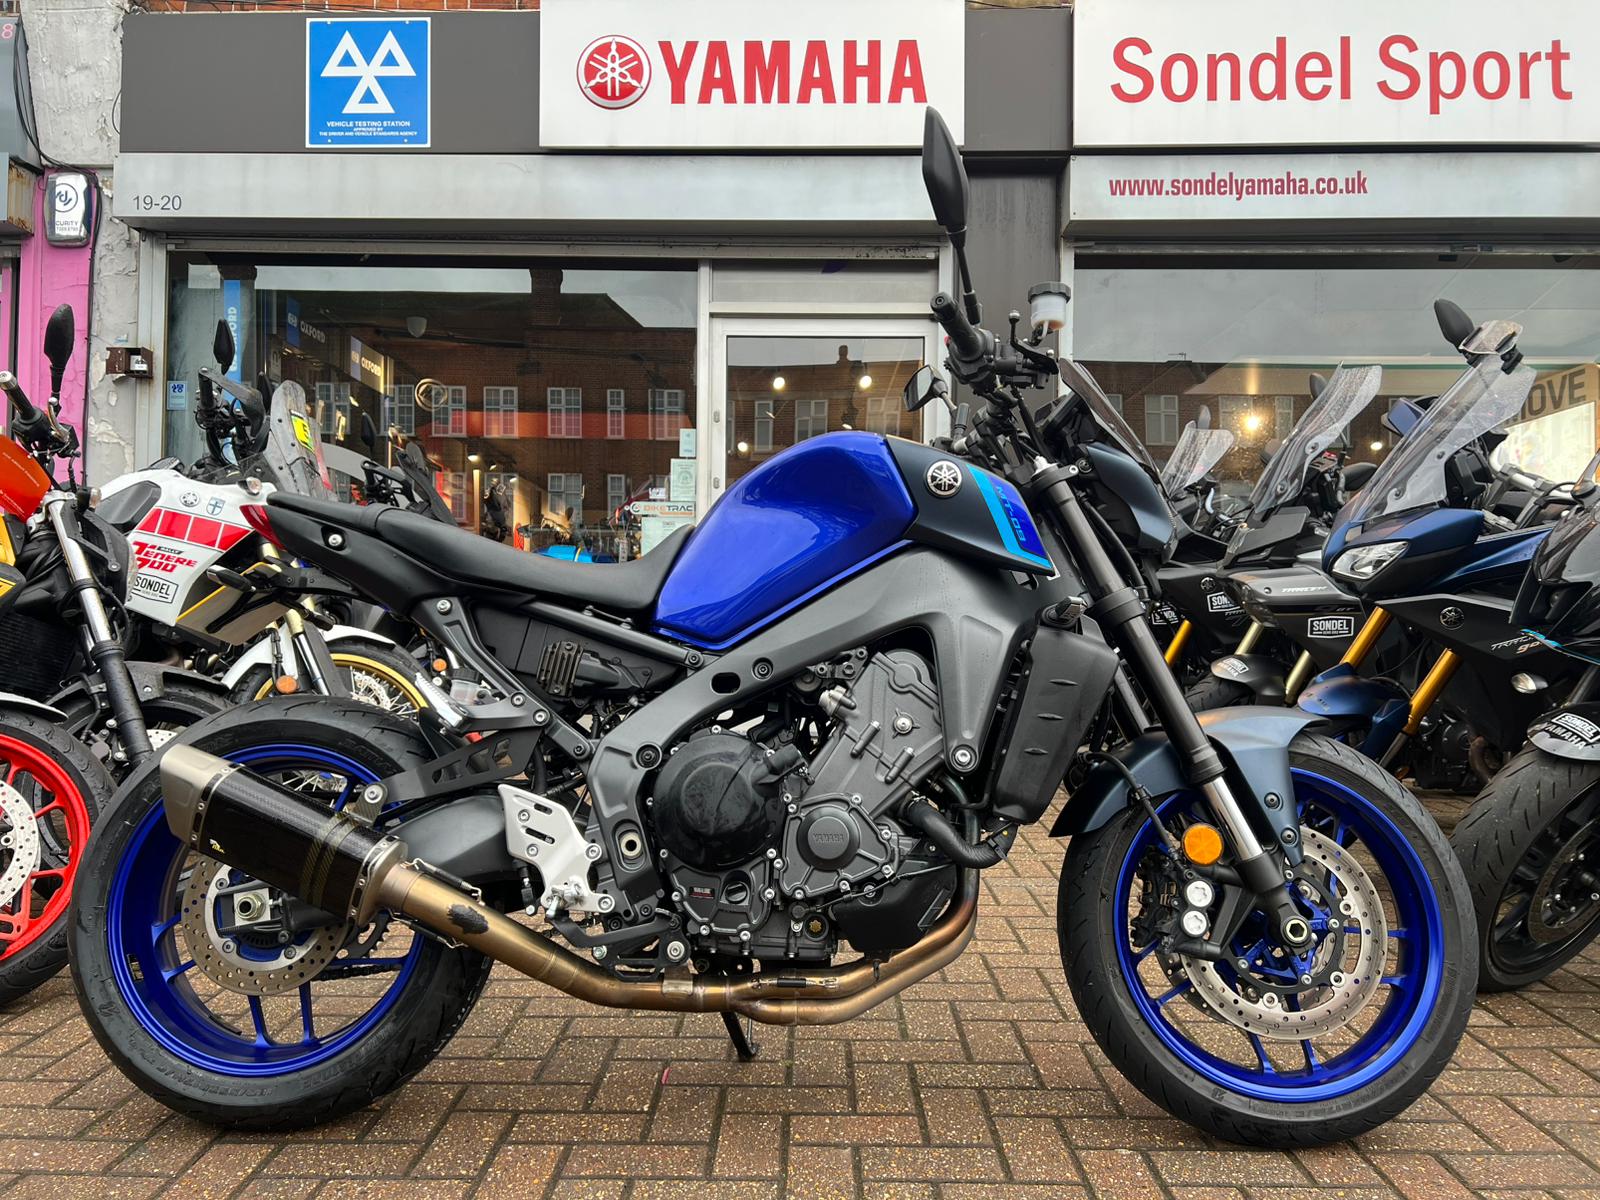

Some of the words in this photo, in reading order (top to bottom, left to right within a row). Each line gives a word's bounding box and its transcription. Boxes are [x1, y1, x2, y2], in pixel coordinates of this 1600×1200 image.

[657, 39, 928, 105] YAMAHA
[1110, 36, 1353, 104] Sondel
[1376, 34, 1573, 116] Sport
[1109, 170, 1368, 201] www.sondelyamaha.co.uk
[132, 194, 182, 211] 19-20
[1520, 368, 1586, 421] OVE
[136, 556, 178, 573] 700
[134, 576, 170, 597] SONDEL
[1312, 619, 1350, 631] SONDEL
